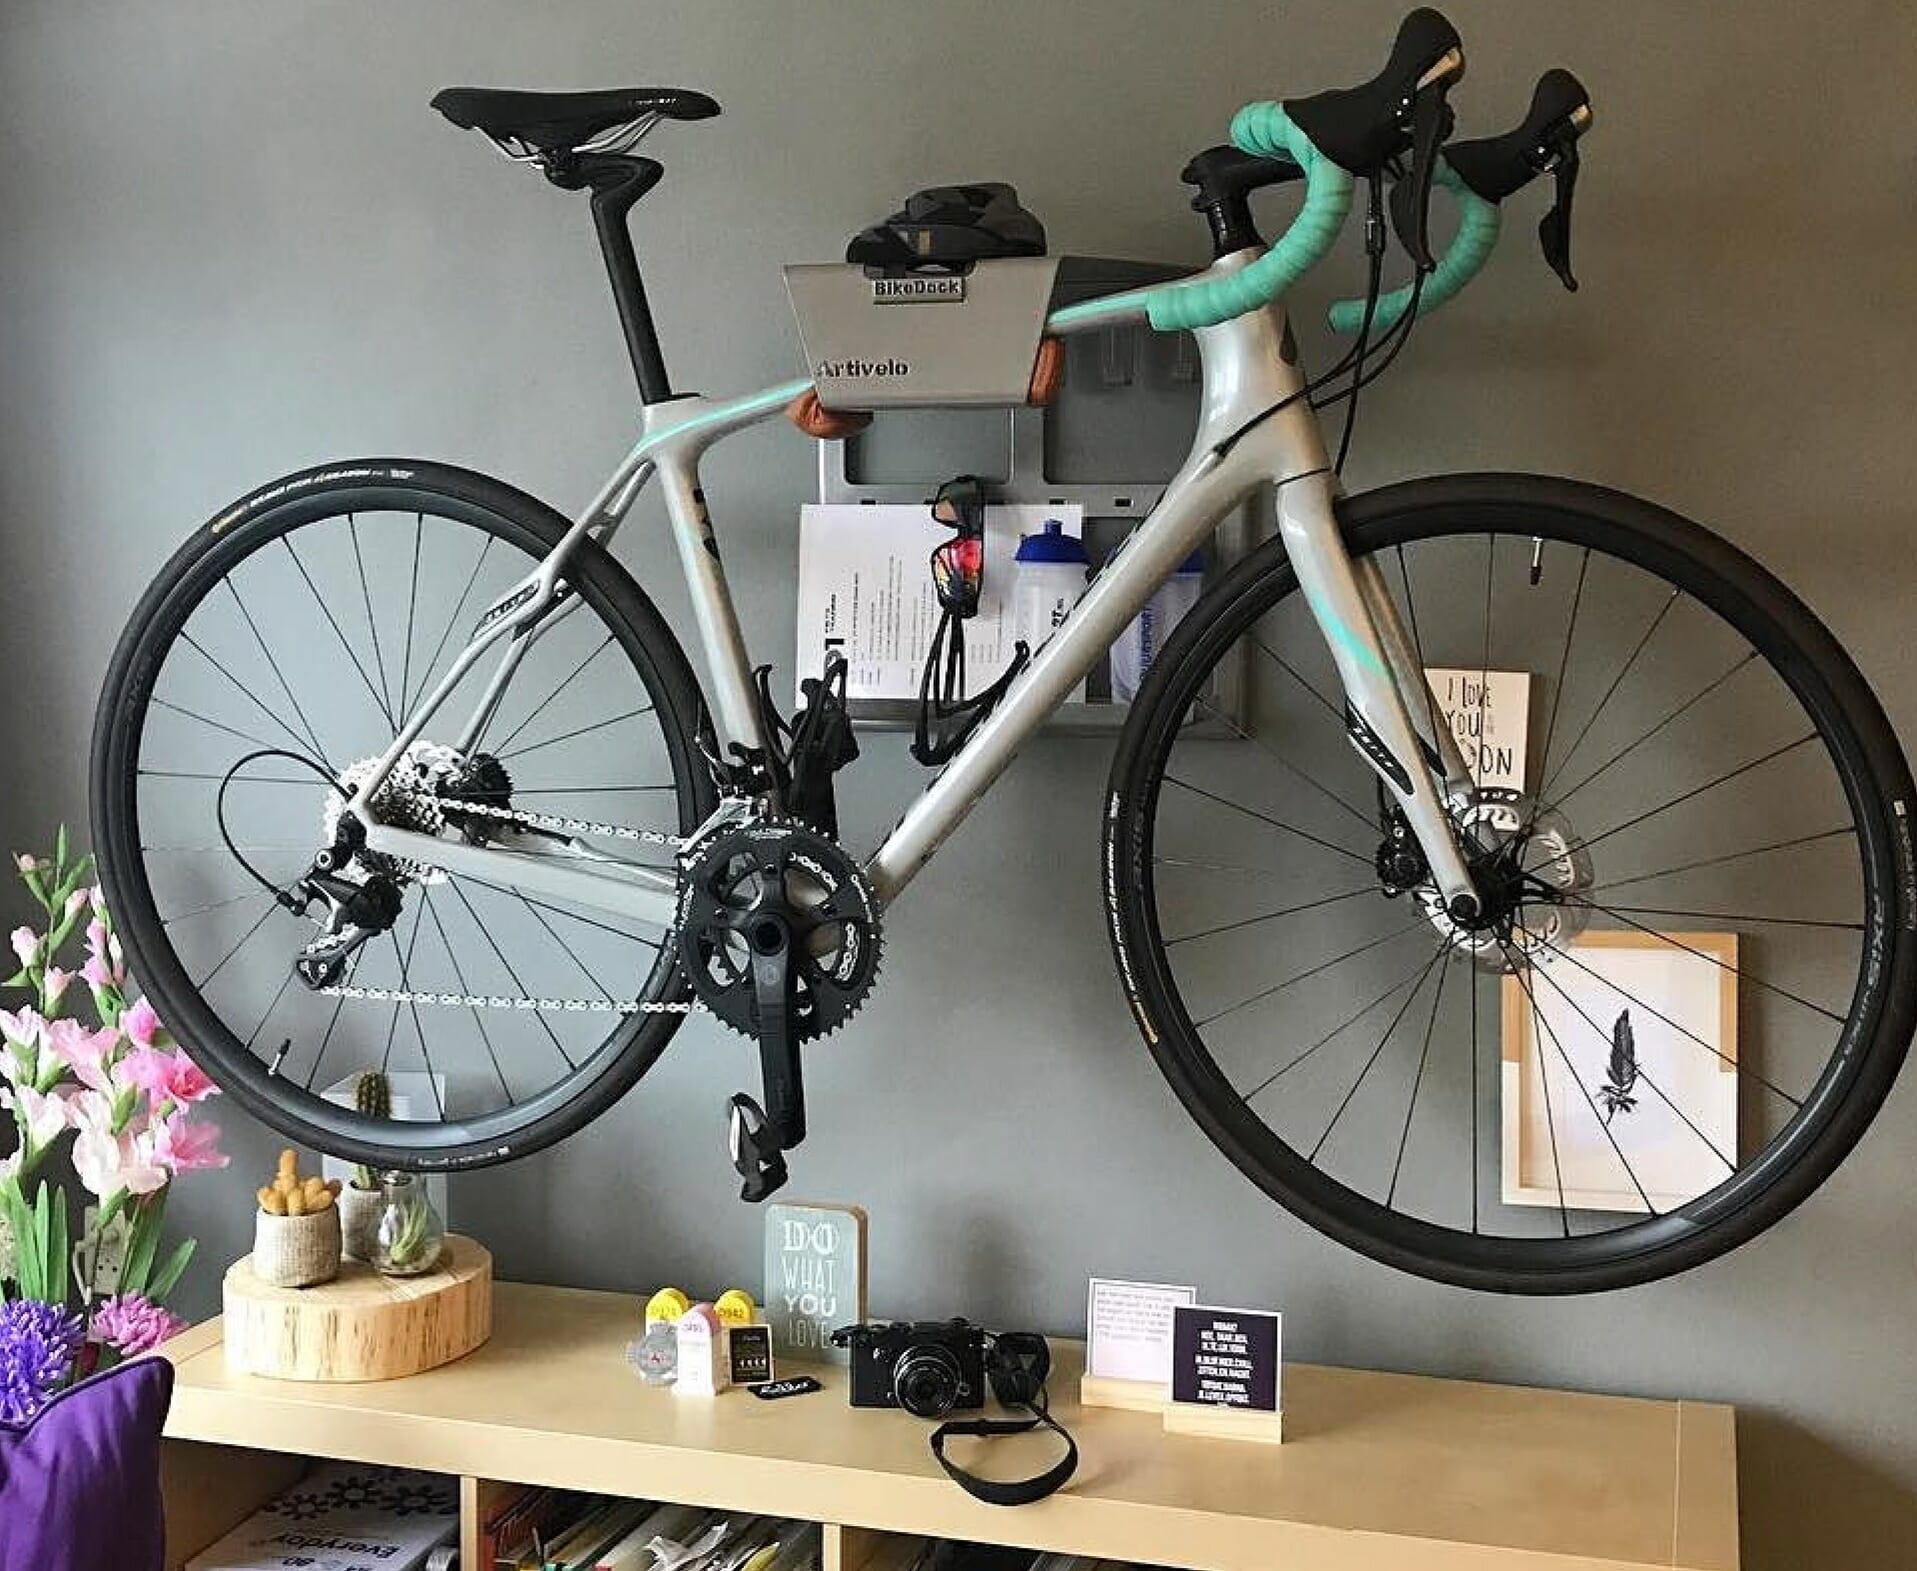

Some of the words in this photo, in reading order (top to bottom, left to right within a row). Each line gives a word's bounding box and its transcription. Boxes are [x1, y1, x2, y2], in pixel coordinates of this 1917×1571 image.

[815, 358, 909, 378] Artivelo
[783, 1220, 840, 1255] DO
[781, 1256, 837, 1294] WHAT
[785, 1294, 836, 1317] YOU
[789, 1319, 830, 1349] LOVE
